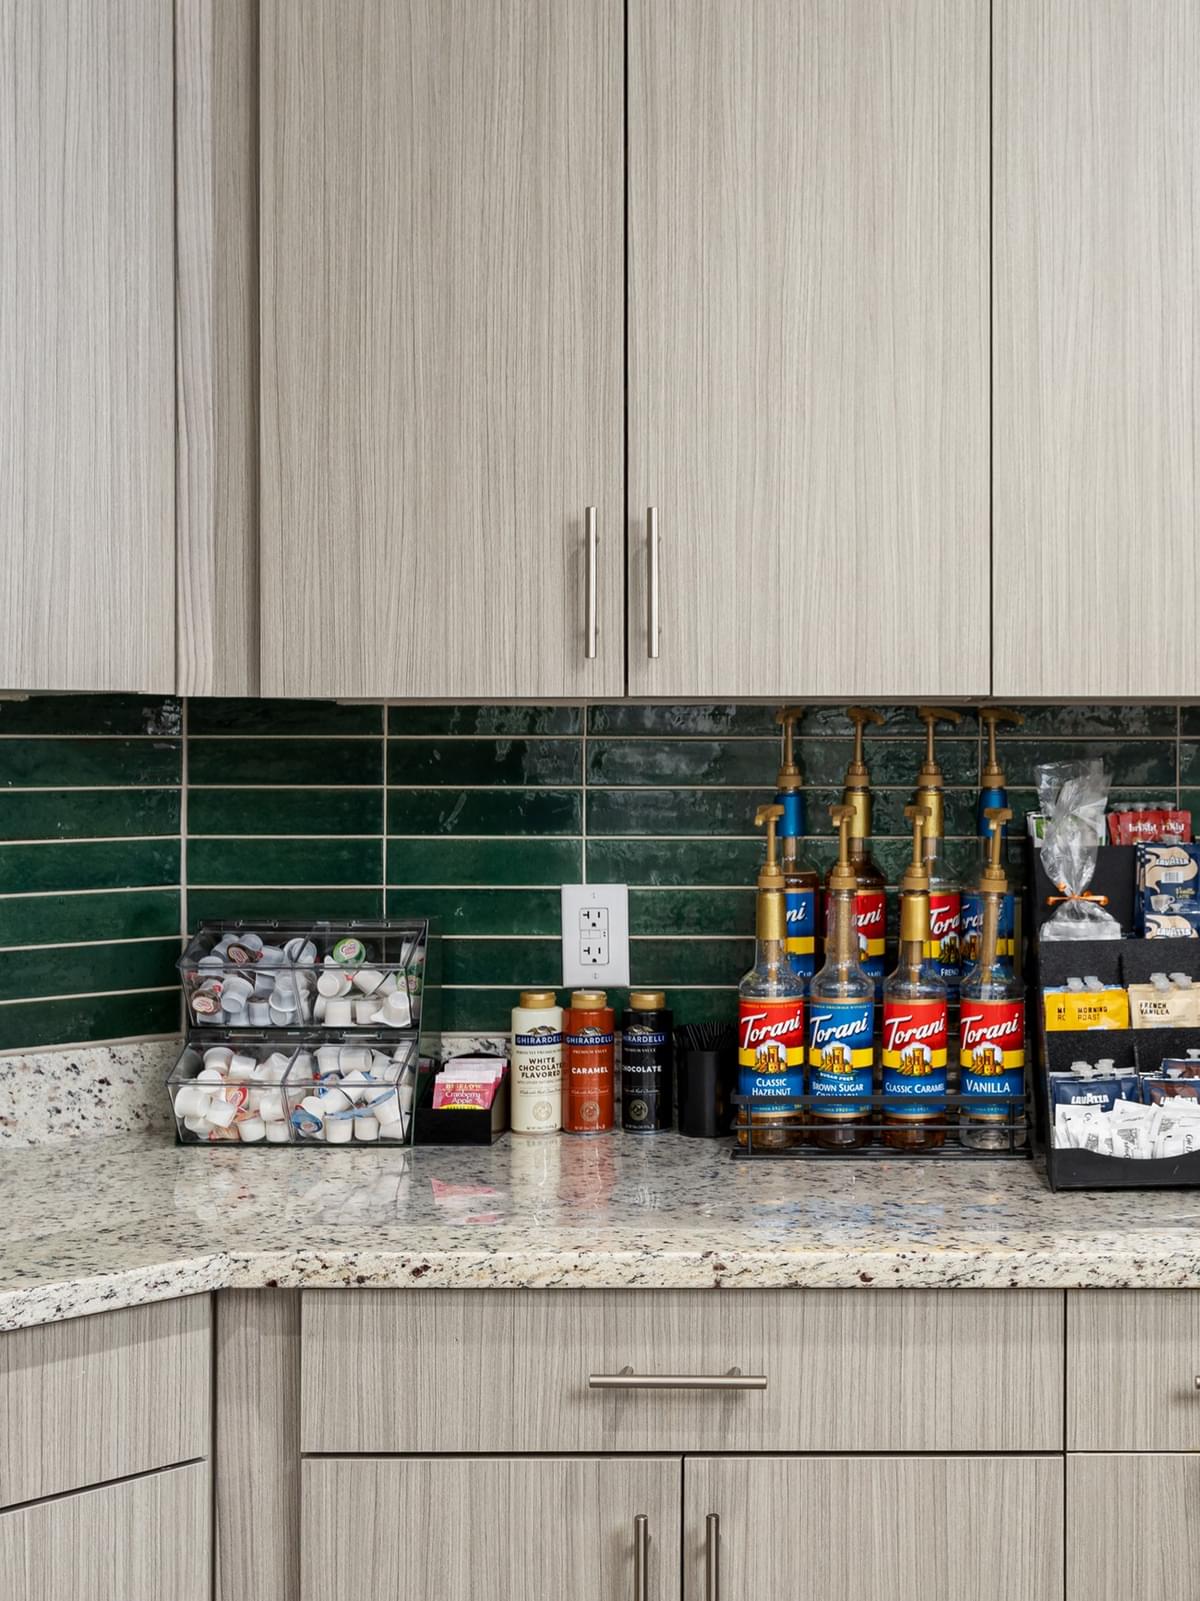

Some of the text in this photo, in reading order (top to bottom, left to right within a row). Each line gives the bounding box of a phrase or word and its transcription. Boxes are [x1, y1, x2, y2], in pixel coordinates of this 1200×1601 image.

[1139, 1008, 1170, 1016] VANILLA
[741, 1010, 800, 1051] Torani
[810, 1012, 868, 1051] Torani
[885, 1012, 945, 1052] Torani
[960, 1012, 1019, 1051] Torani
[529, 1056, 556, 1064] WHITE
[623, 1065, 662, 1073] HOCOLATE
[756, 1077, 787, 1087] CLASSIC
[813, 1081, 864, 1093] BROWN SUGAR
[885, 1082, 913, 1093] CLASSIC
[966, 1078, 1011, 1093] VANILLA
[752, 1087, 791, 1096] HAZELNUT
[1071, 1093, 1109, 1105] LAVAZZA
